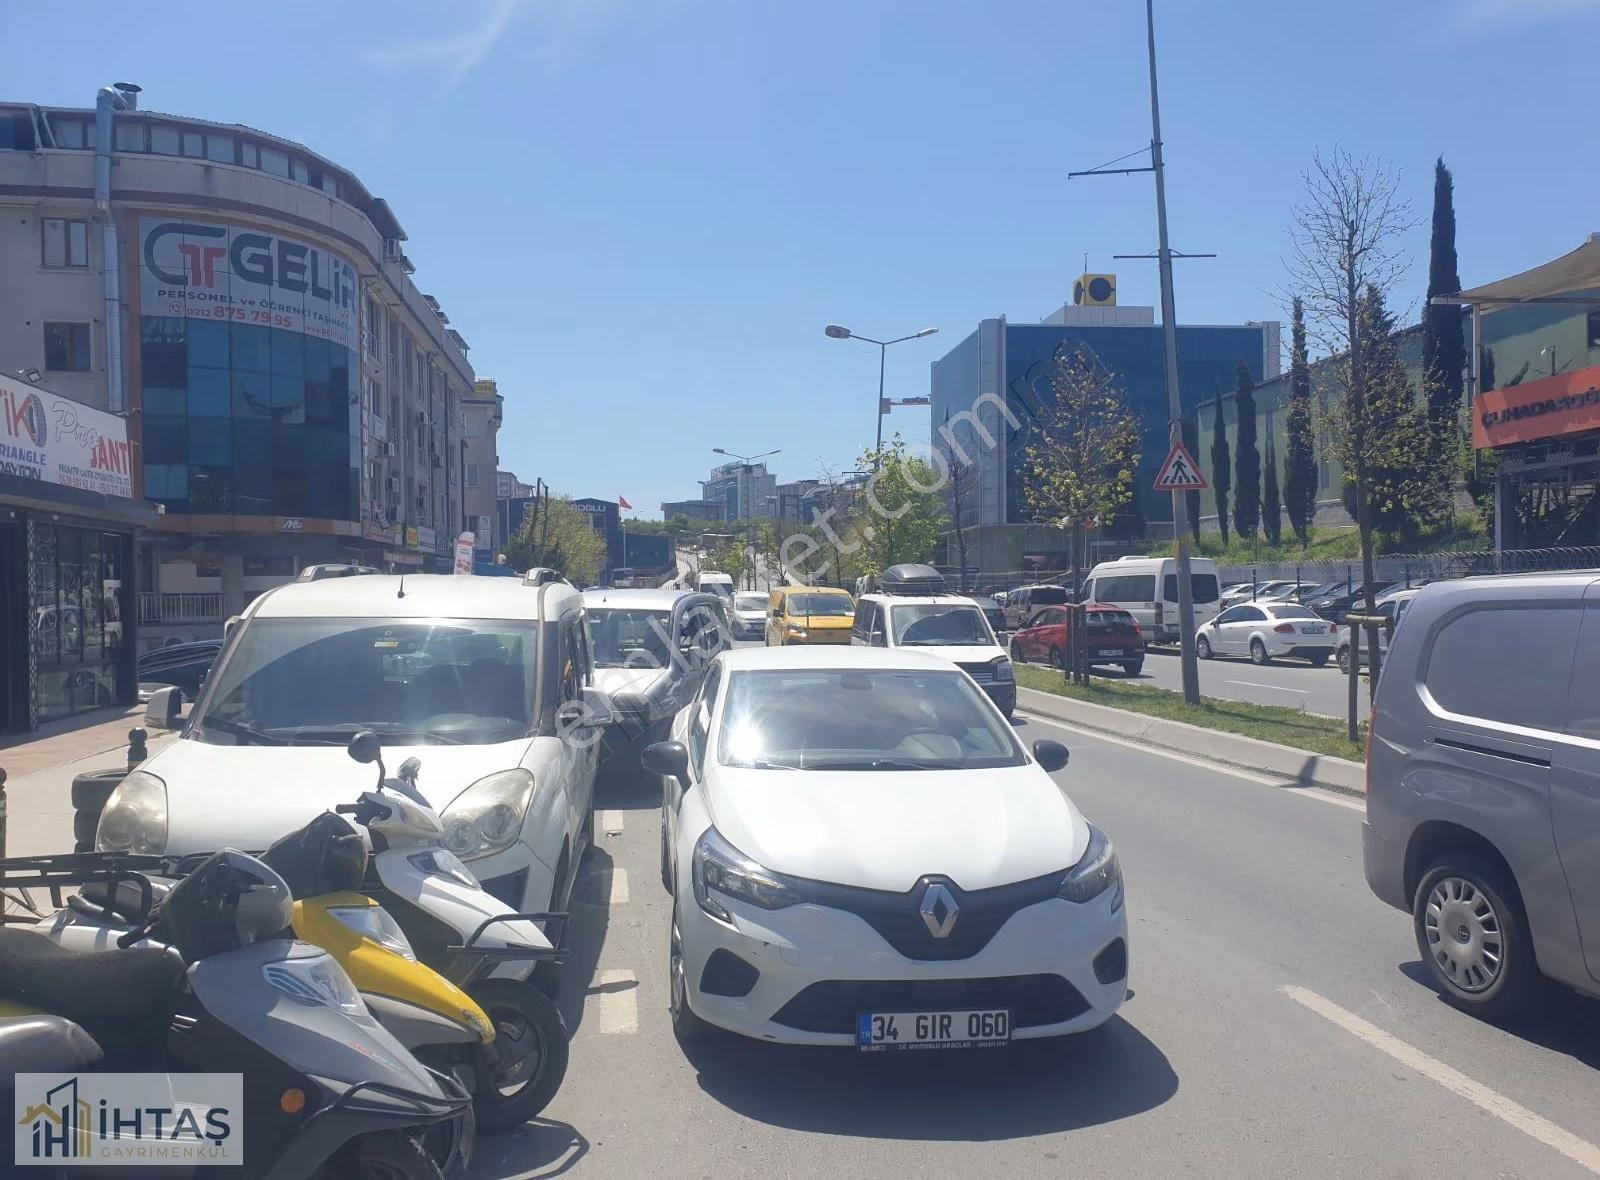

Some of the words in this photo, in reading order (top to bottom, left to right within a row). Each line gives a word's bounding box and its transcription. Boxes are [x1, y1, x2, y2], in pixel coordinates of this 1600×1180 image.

[157, 289, 235, 304] PERSONEL
[259, 297, 311, 317] ÖĞRENCİ
[187, 308, 211, 317] 0212
[214, 305, 246, 321] 875
[873, 1015, 899, 1041] 34
[915, 1014, 952, 1039] GIR
[968, 1012, 1007, 1037] 060
